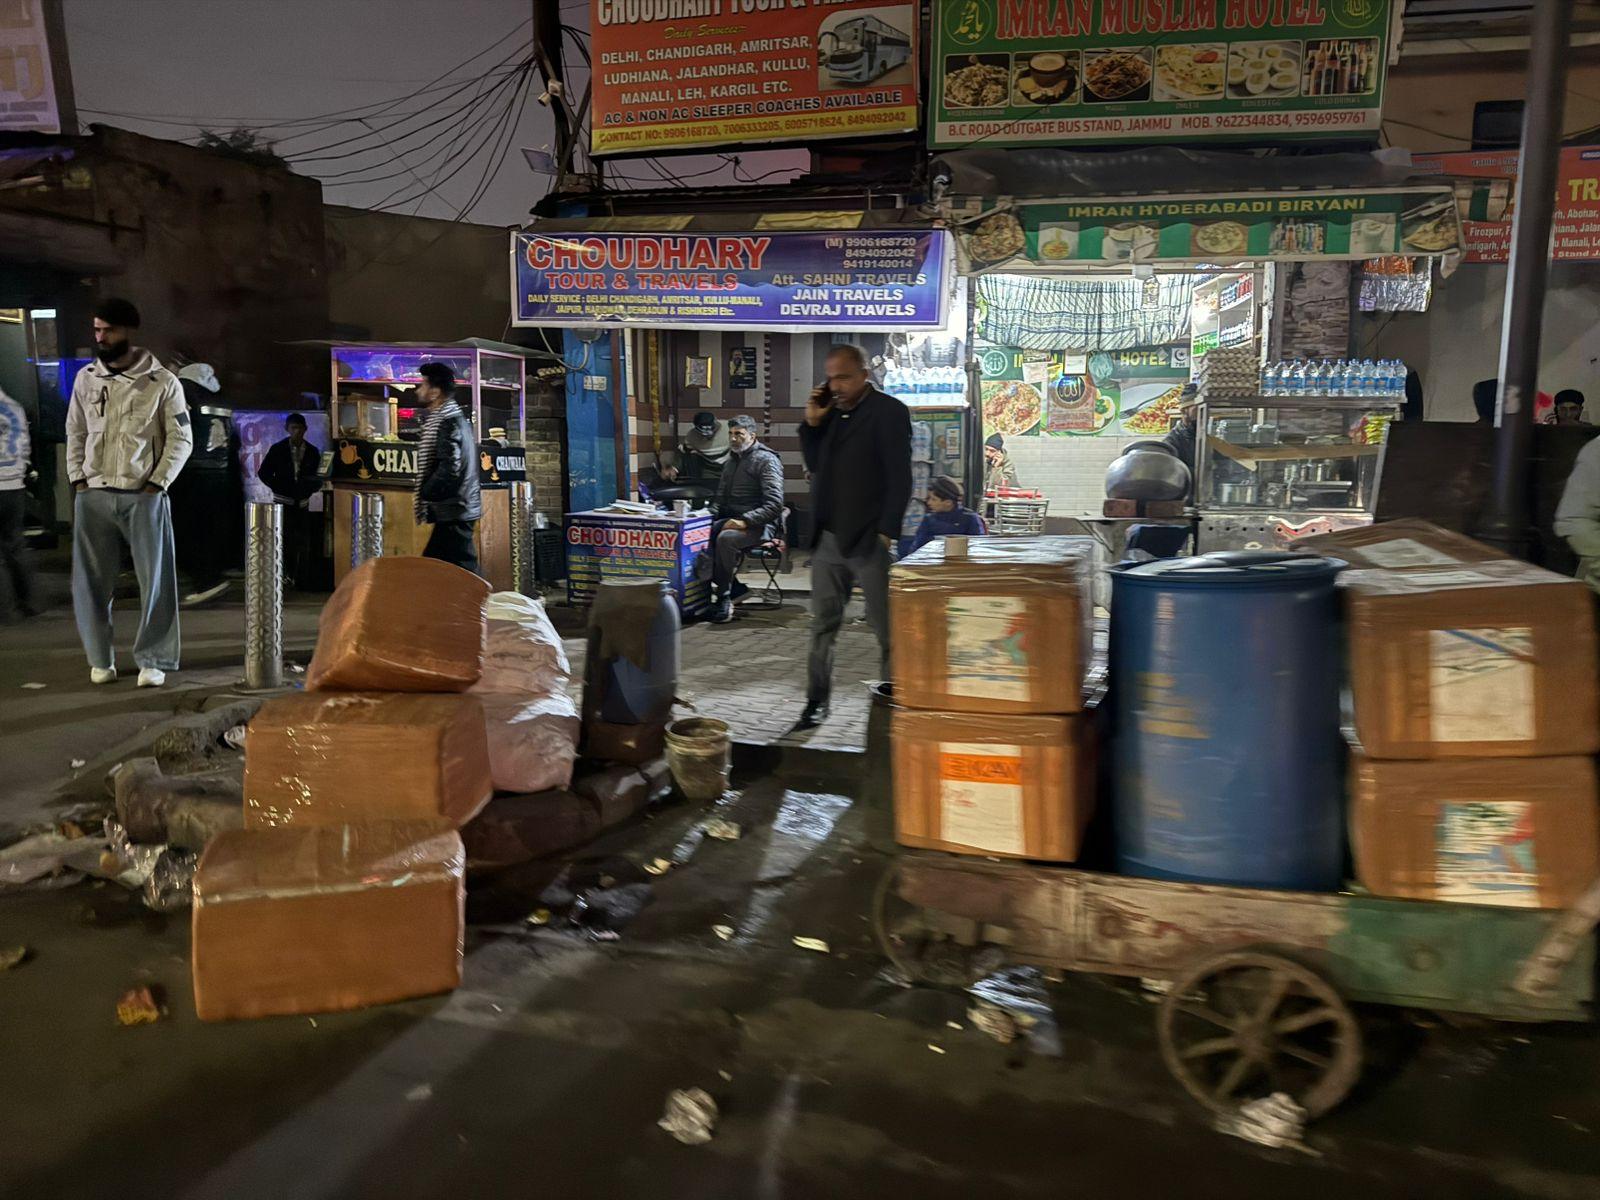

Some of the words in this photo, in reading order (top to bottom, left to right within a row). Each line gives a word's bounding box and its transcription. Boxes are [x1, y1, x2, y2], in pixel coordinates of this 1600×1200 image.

[995, 0, 1092, 39] IMRAN
[1099, 0, 1217, 35] MUSLIM
[1224, 0, 1326, 29] HOTEL
[601, 51, 643, 65] DELHI,
[646, 43, 737, 61] CHANDIGARH,
[739, 36, 813, 53] AMRITSAR,
[604, 69, 673, 85] LUDHIANA,
[676, 62, 759, 80] JALANDHAR,
[762, 58, 811, 72] KULLU,
[621, 90, 674, 105] MANALI,
[710, 83, 760, 98] KARGIL
[763, 80, 793, 93] ETC.
[604, 113, 622, 125] AC
[625, 112, 635, 123] &
[639, 108, 668, 122] NON
[671, 107, 689, 120] AC
[693, 103, 752, 118] SLEEPER
[756, 97, 821, 113] COACHES
[825, 91, 902, 108] AVAILABLE
[600, 130, 643, 143] CONTACT
[948, 124, 967, 137] B.C
[968, 123, 1000, 136] ROAD
[1002, 121, 1055, 135] OUTGATE
[1057, 121, 1081, 133] BUS
[1083, 119, 1124, 133] STAND,
[1126, 117, 1171, 131] JAMMU
[1181, 116, 1213, 129] MOB.
[1216, 114, 1292, 128] 9622344834,
[1295, 112, 1366, 125] 9596959761
[1568, 178, 1600, 201] TR
[1068, 205, 1133, 218] IMRAN
[1138, 201, 1272, 216] HYDERABADI
[1278, 198, 1365, 213] BIRYANI
[527, 237, 771, 270] CHOUDHARY
[825, 237, 843, 249] (M)
[545, 272, 607, 290] TOUR
[611, 272, 630, 290] &
[635, 272, 739, 291] TRAVELS
[803, 273, 851, 285] SAHNI
[855, 273, 927, 285] TRAVELS
[792, 288, 828, 301] JAIN
[832, 288, 904, 301] TRAVELS
[780, 303, 841, 316] DEVRAJ
[844, 303, 916, 316] TRAVELS
[373, 448, 418, 474] CHAI
[567, 526, 679, 551] CHOUDHARY
